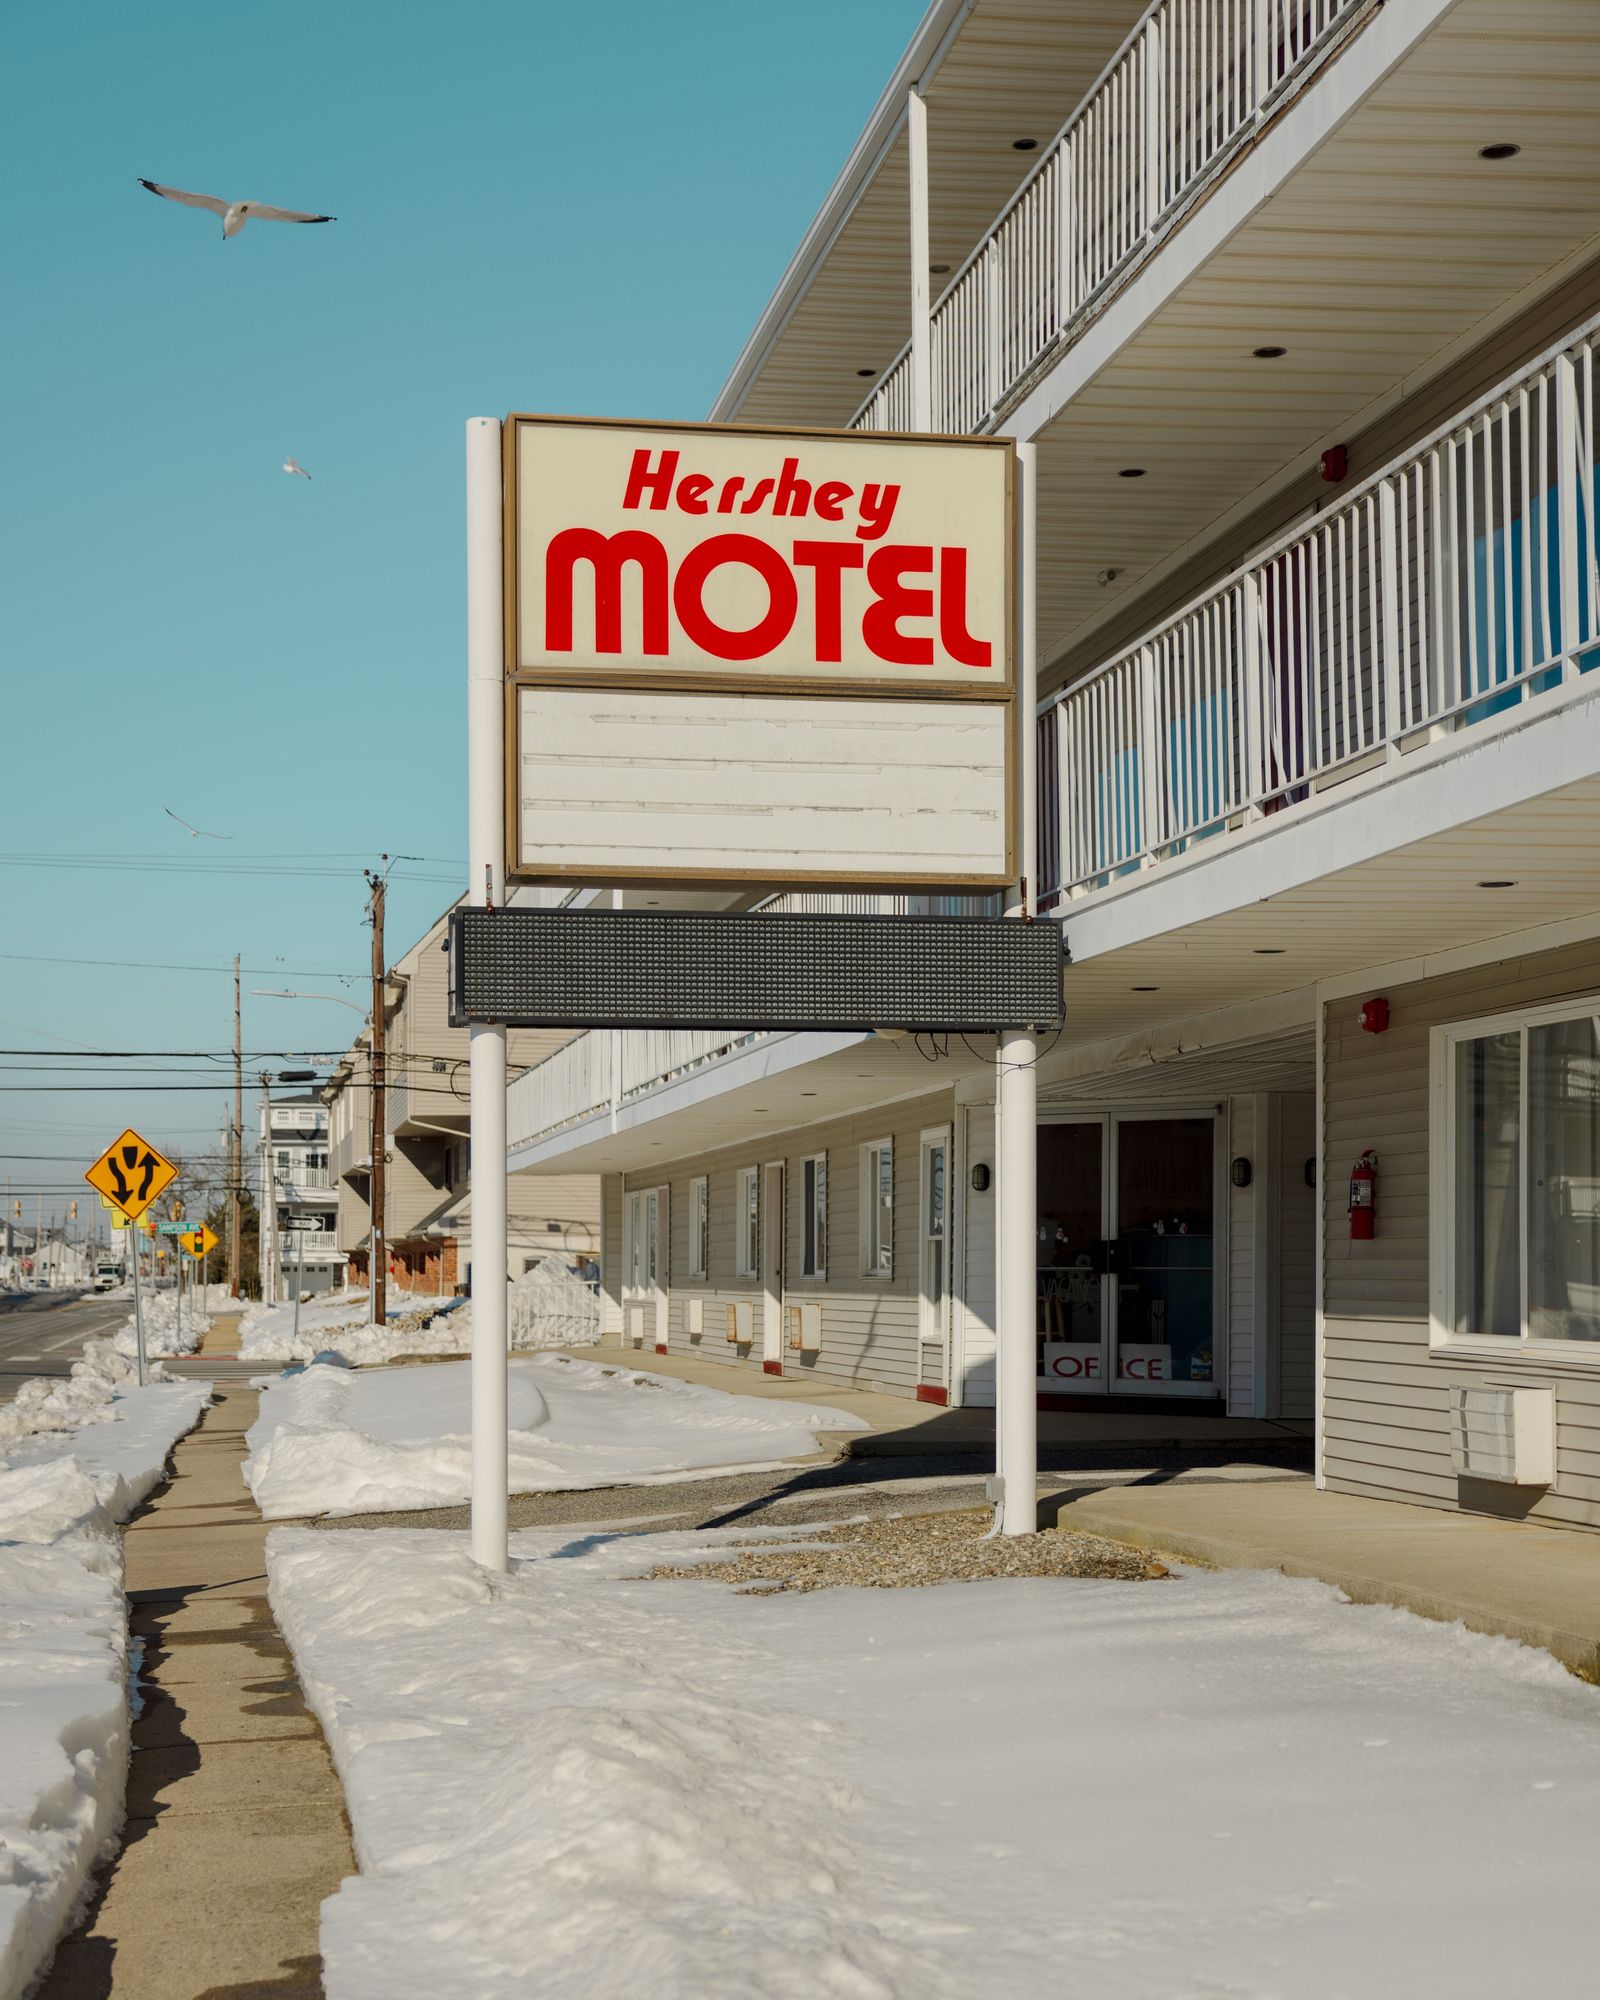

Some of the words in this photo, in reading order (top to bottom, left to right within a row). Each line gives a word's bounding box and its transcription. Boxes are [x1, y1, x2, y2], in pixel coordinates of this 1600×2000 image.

[623, 450, 900, 540] Hershey
[546, 528, 991, 667] MOTEL
[1041, 1278, 1101, 1303] VACANC
[1052, 1356, 1162, 1380] OFICE
